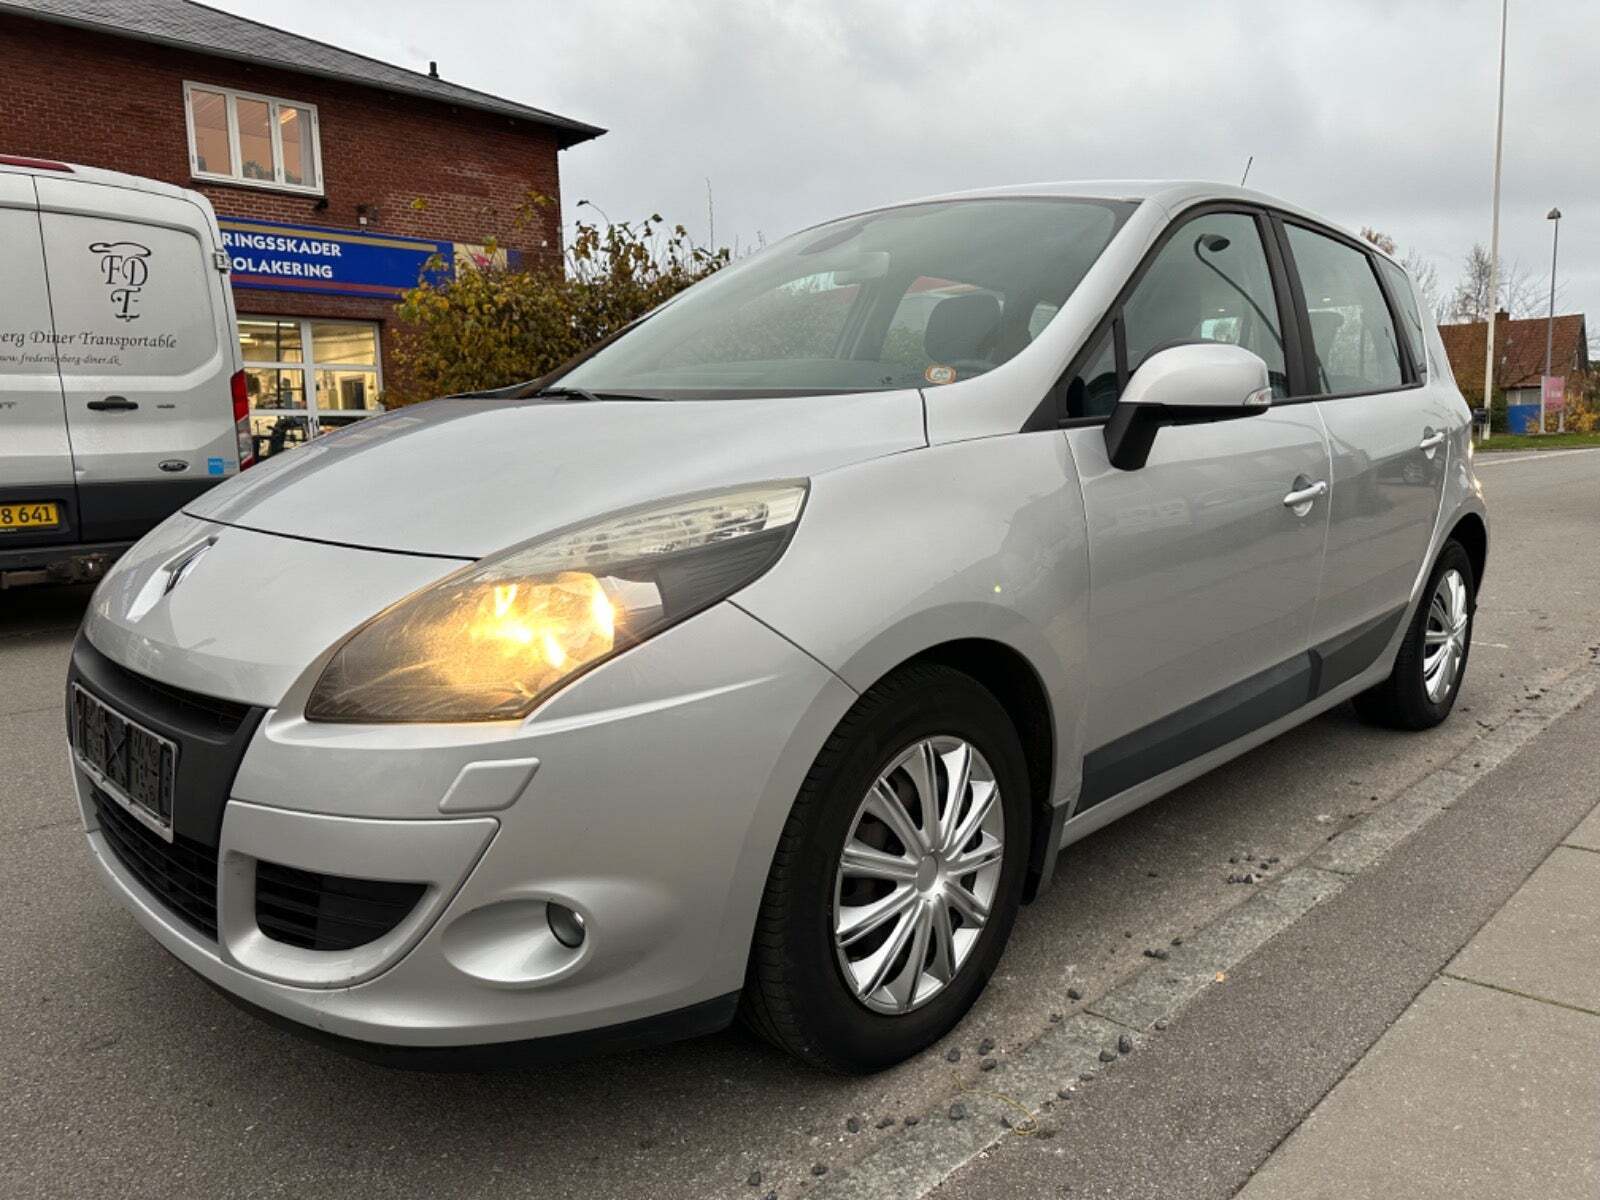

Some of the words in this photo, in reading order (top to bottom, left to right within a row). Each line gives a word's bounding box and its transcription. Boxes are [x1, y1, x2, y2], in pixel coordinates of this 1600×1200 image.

[221, 232, 341, 257] RINGSSKADER
[232, 256, 333, 279] OLAKERING
[0, 332, 25, 347] erg
[30, 330, 76, 344] Diner
[79, 331, 177, 350] Transportable
[18, 505, 53, 523] 641
